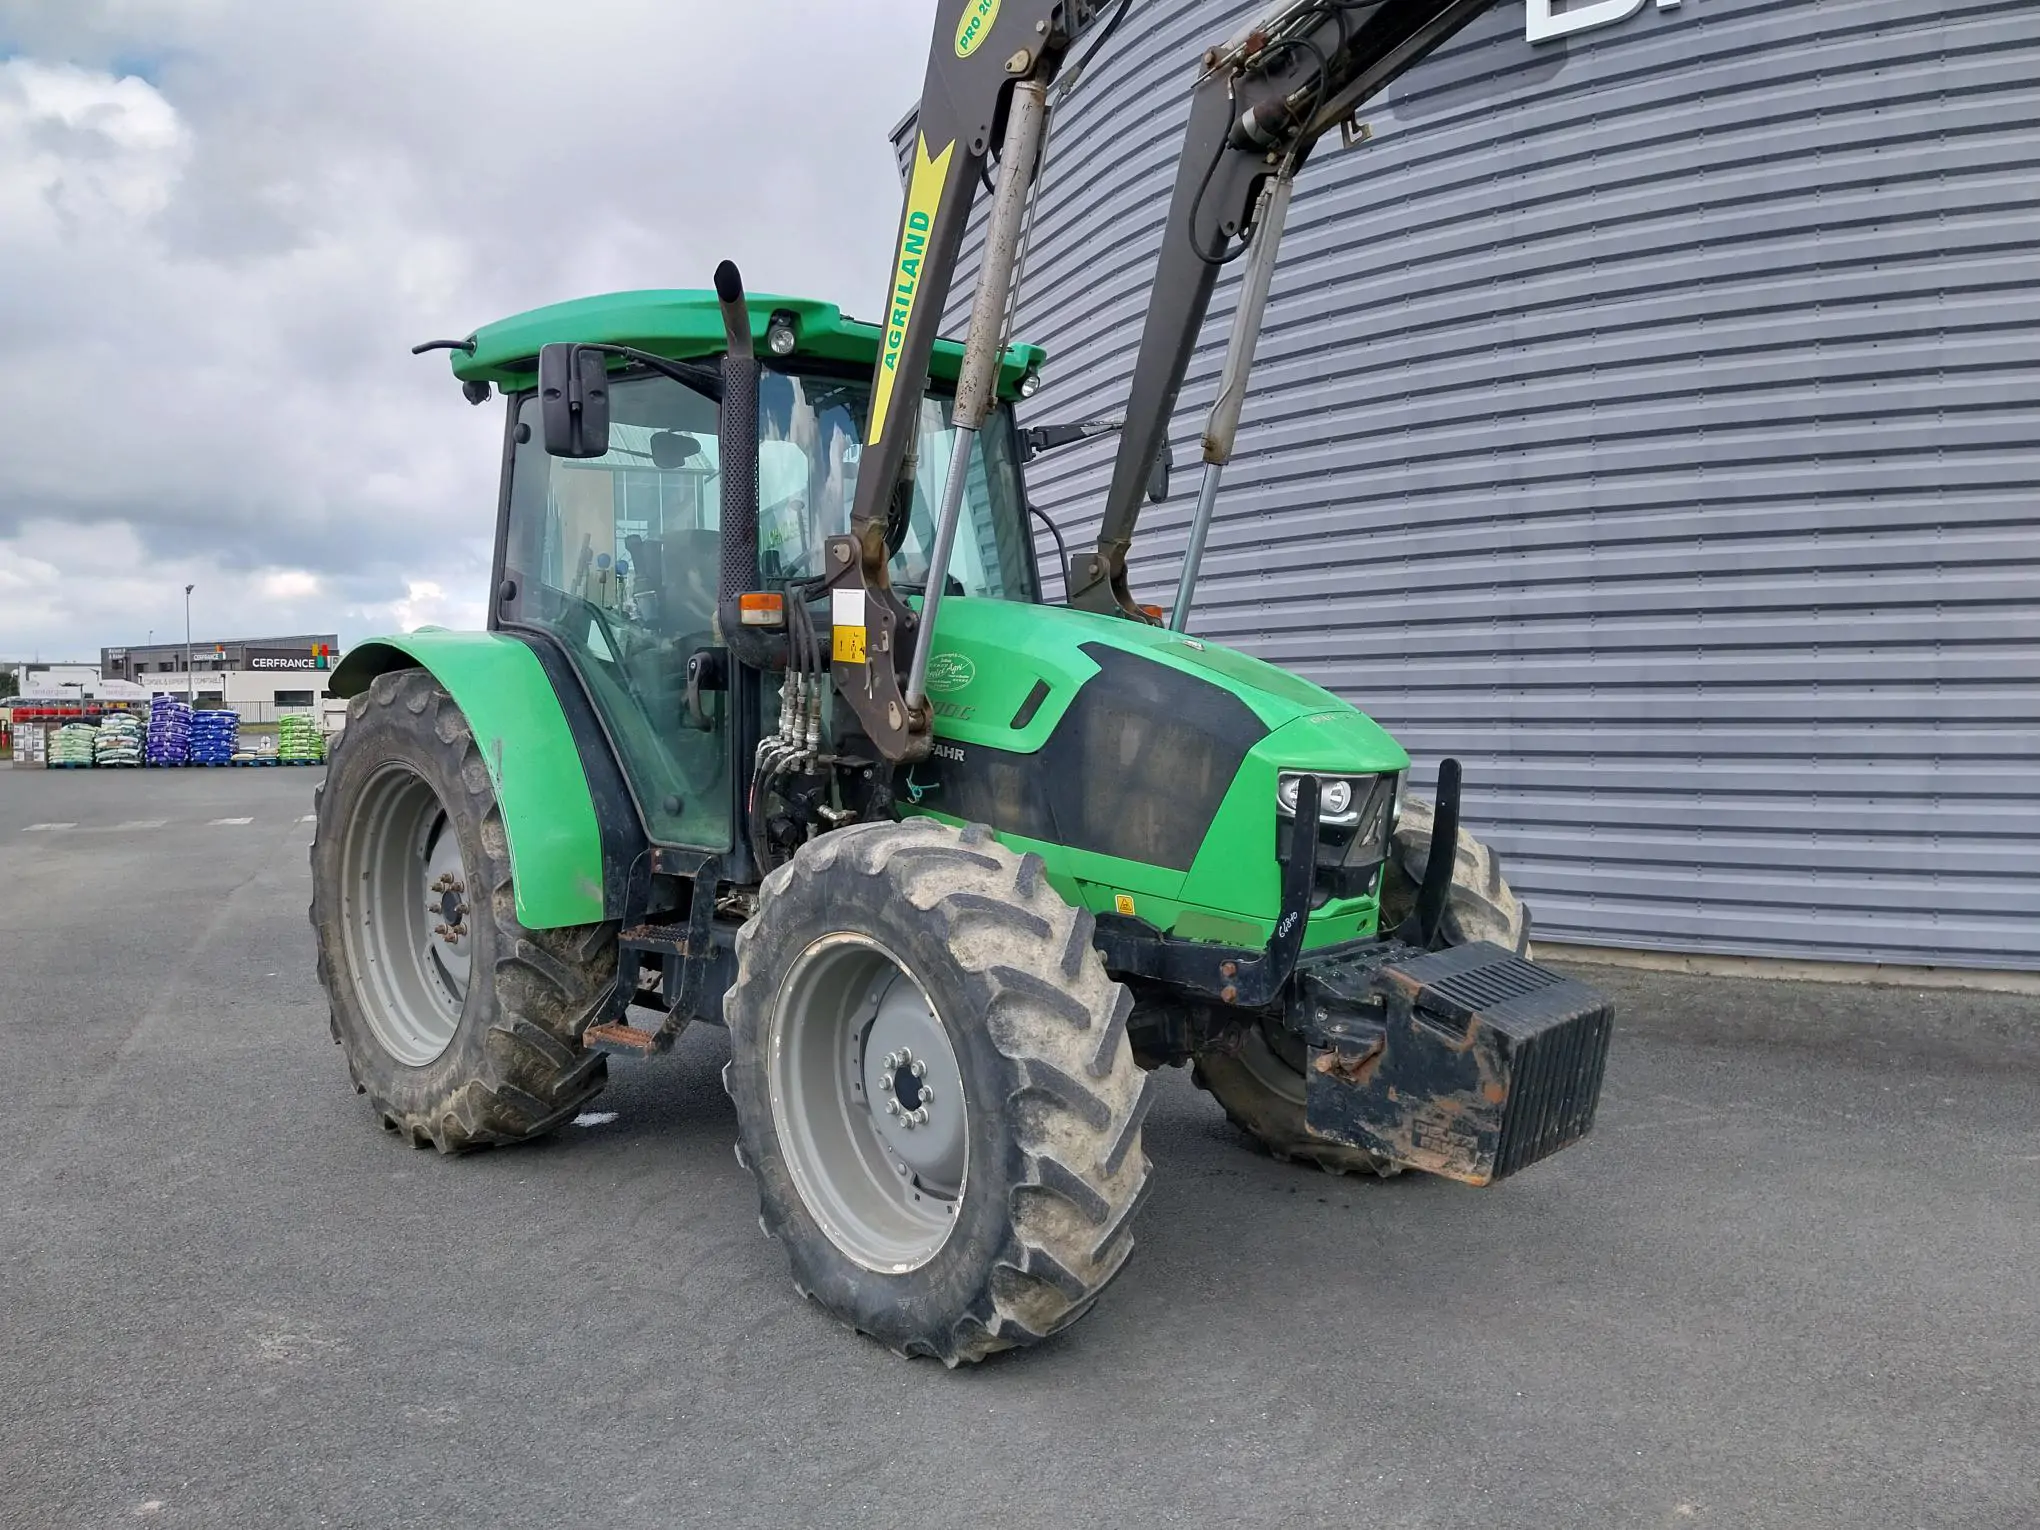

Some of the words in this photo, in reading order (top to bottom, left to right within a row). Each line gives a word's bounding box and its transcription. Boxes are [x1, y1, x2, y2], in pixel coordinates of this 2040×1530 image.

[960, 16, 980, 50] PRO
[884, 211, 930, 371] AGRILAND
[193, 653, 219, 661] CERFRANCE
[252, 657, 315, 668] CERFRANCE
